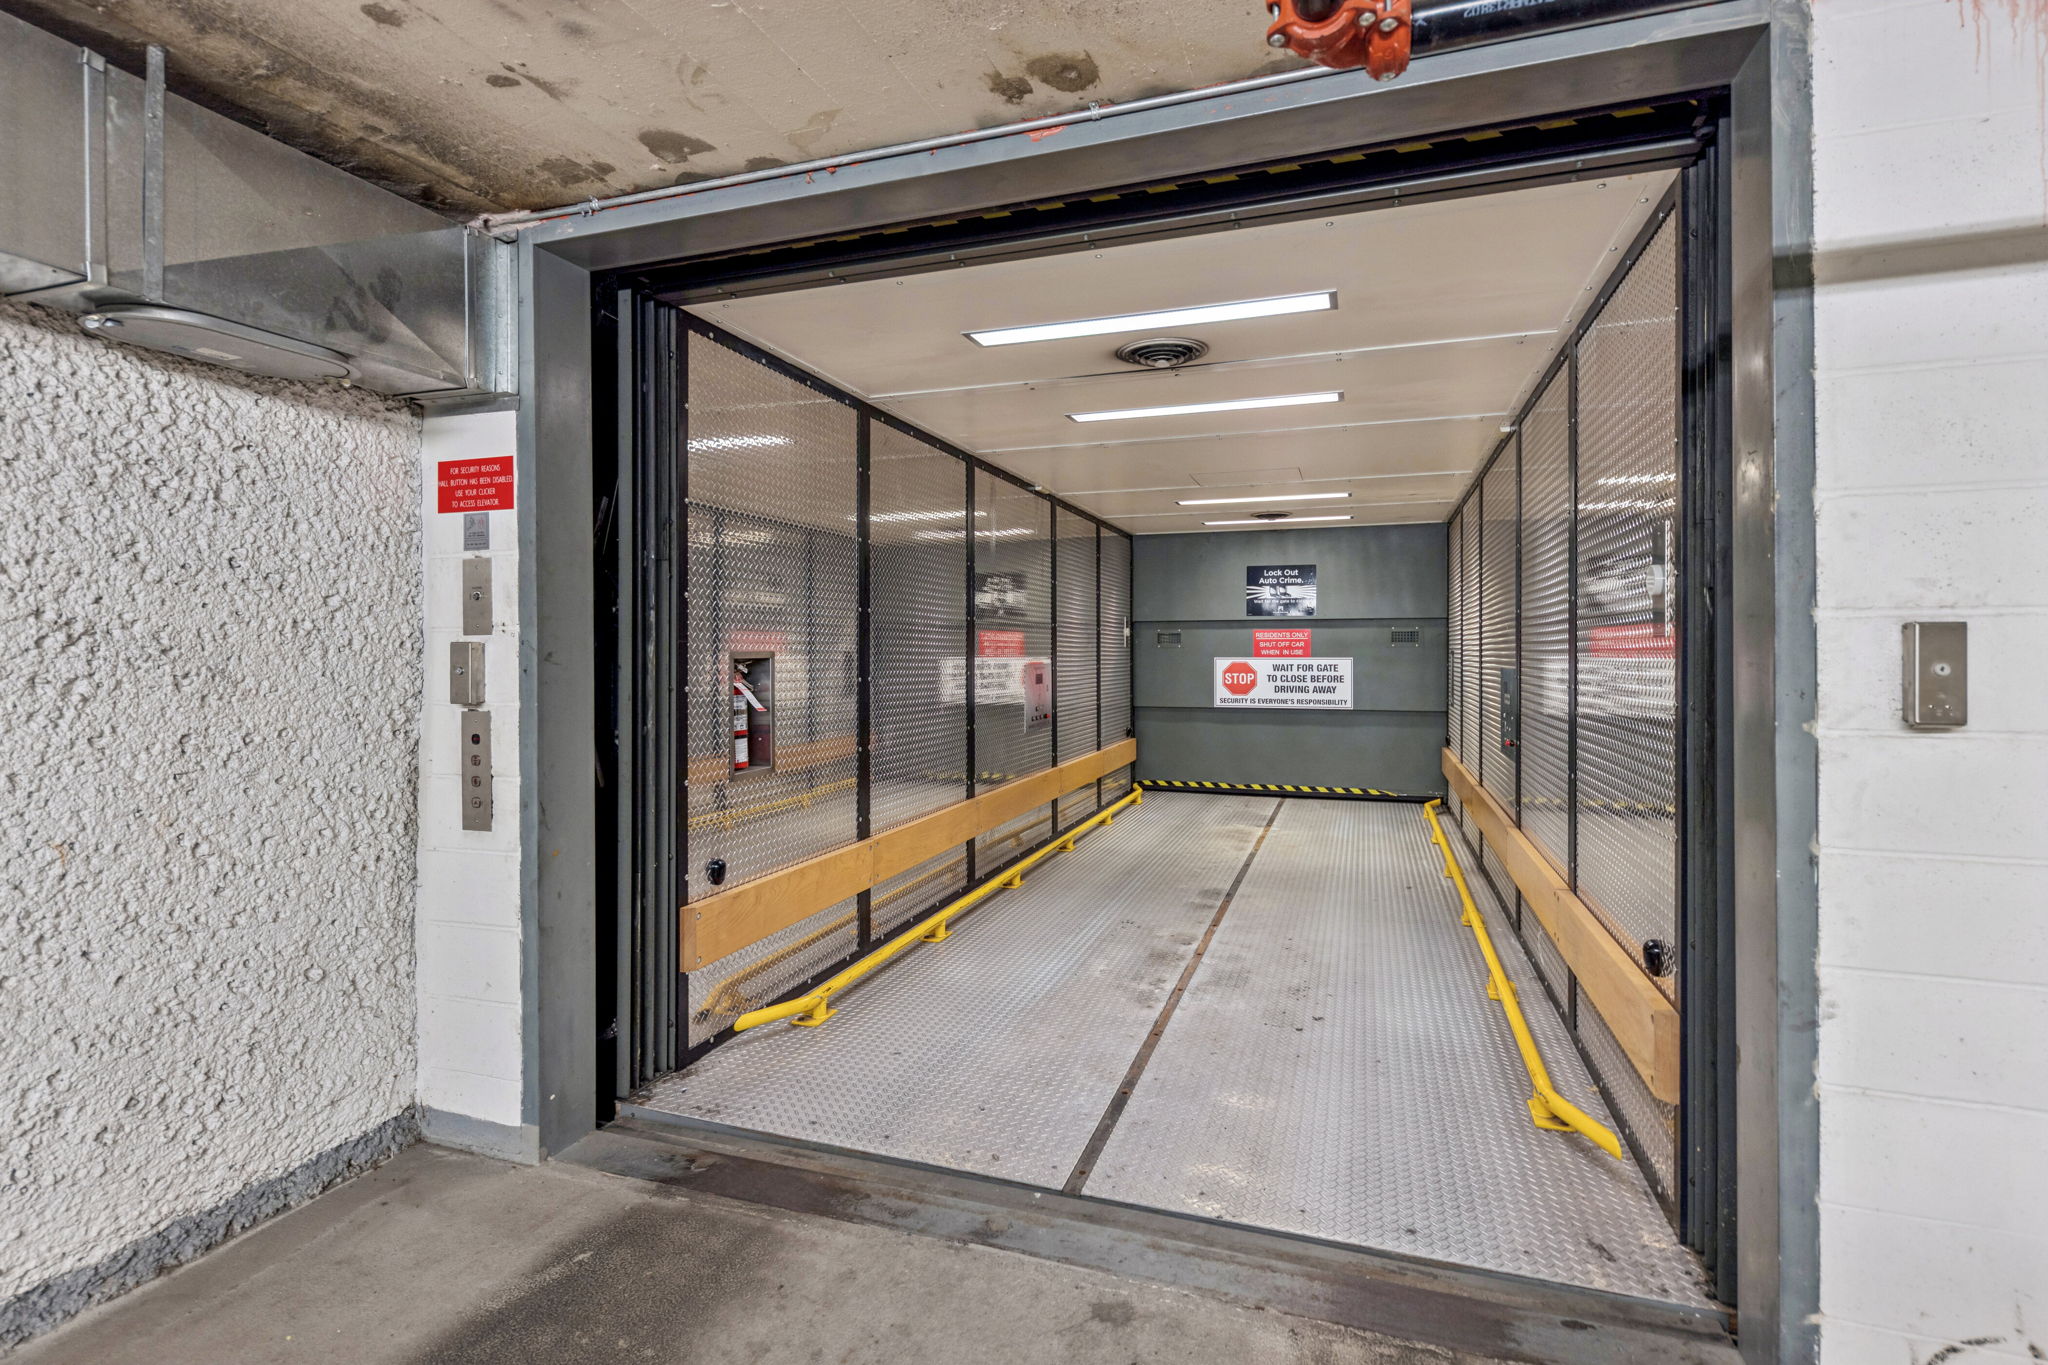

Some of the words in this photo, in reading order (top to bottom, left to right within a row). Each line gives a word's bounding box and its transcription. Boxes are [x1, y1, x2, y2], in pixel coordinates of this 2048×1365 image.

[450, 467, 459, 475] FOR
[460, 466, 480, 474] SECURITY
[481, 464, 501, 472] REASONS
[450, 479, 468, 487] BUTTON
[480, 477, 491, 485] BEEN
[460, 499, 476, 507] ACCESS
[1272, 664, 1294, 672] WAIT
[1296, 664, 1314, 672] FOR
[1316, 664, 1339, 672] GATE
[1224, 673, 1255, 685] STOP
[1267, 675, 1278, 683] TO
[1280, 675, 1308, 683] CLOSE
[1310, 675, 1345, 683] BEFORE
[1274, 686, 1310, 694] DRIVING
[1312, 686, 1337, 694] AWAY
